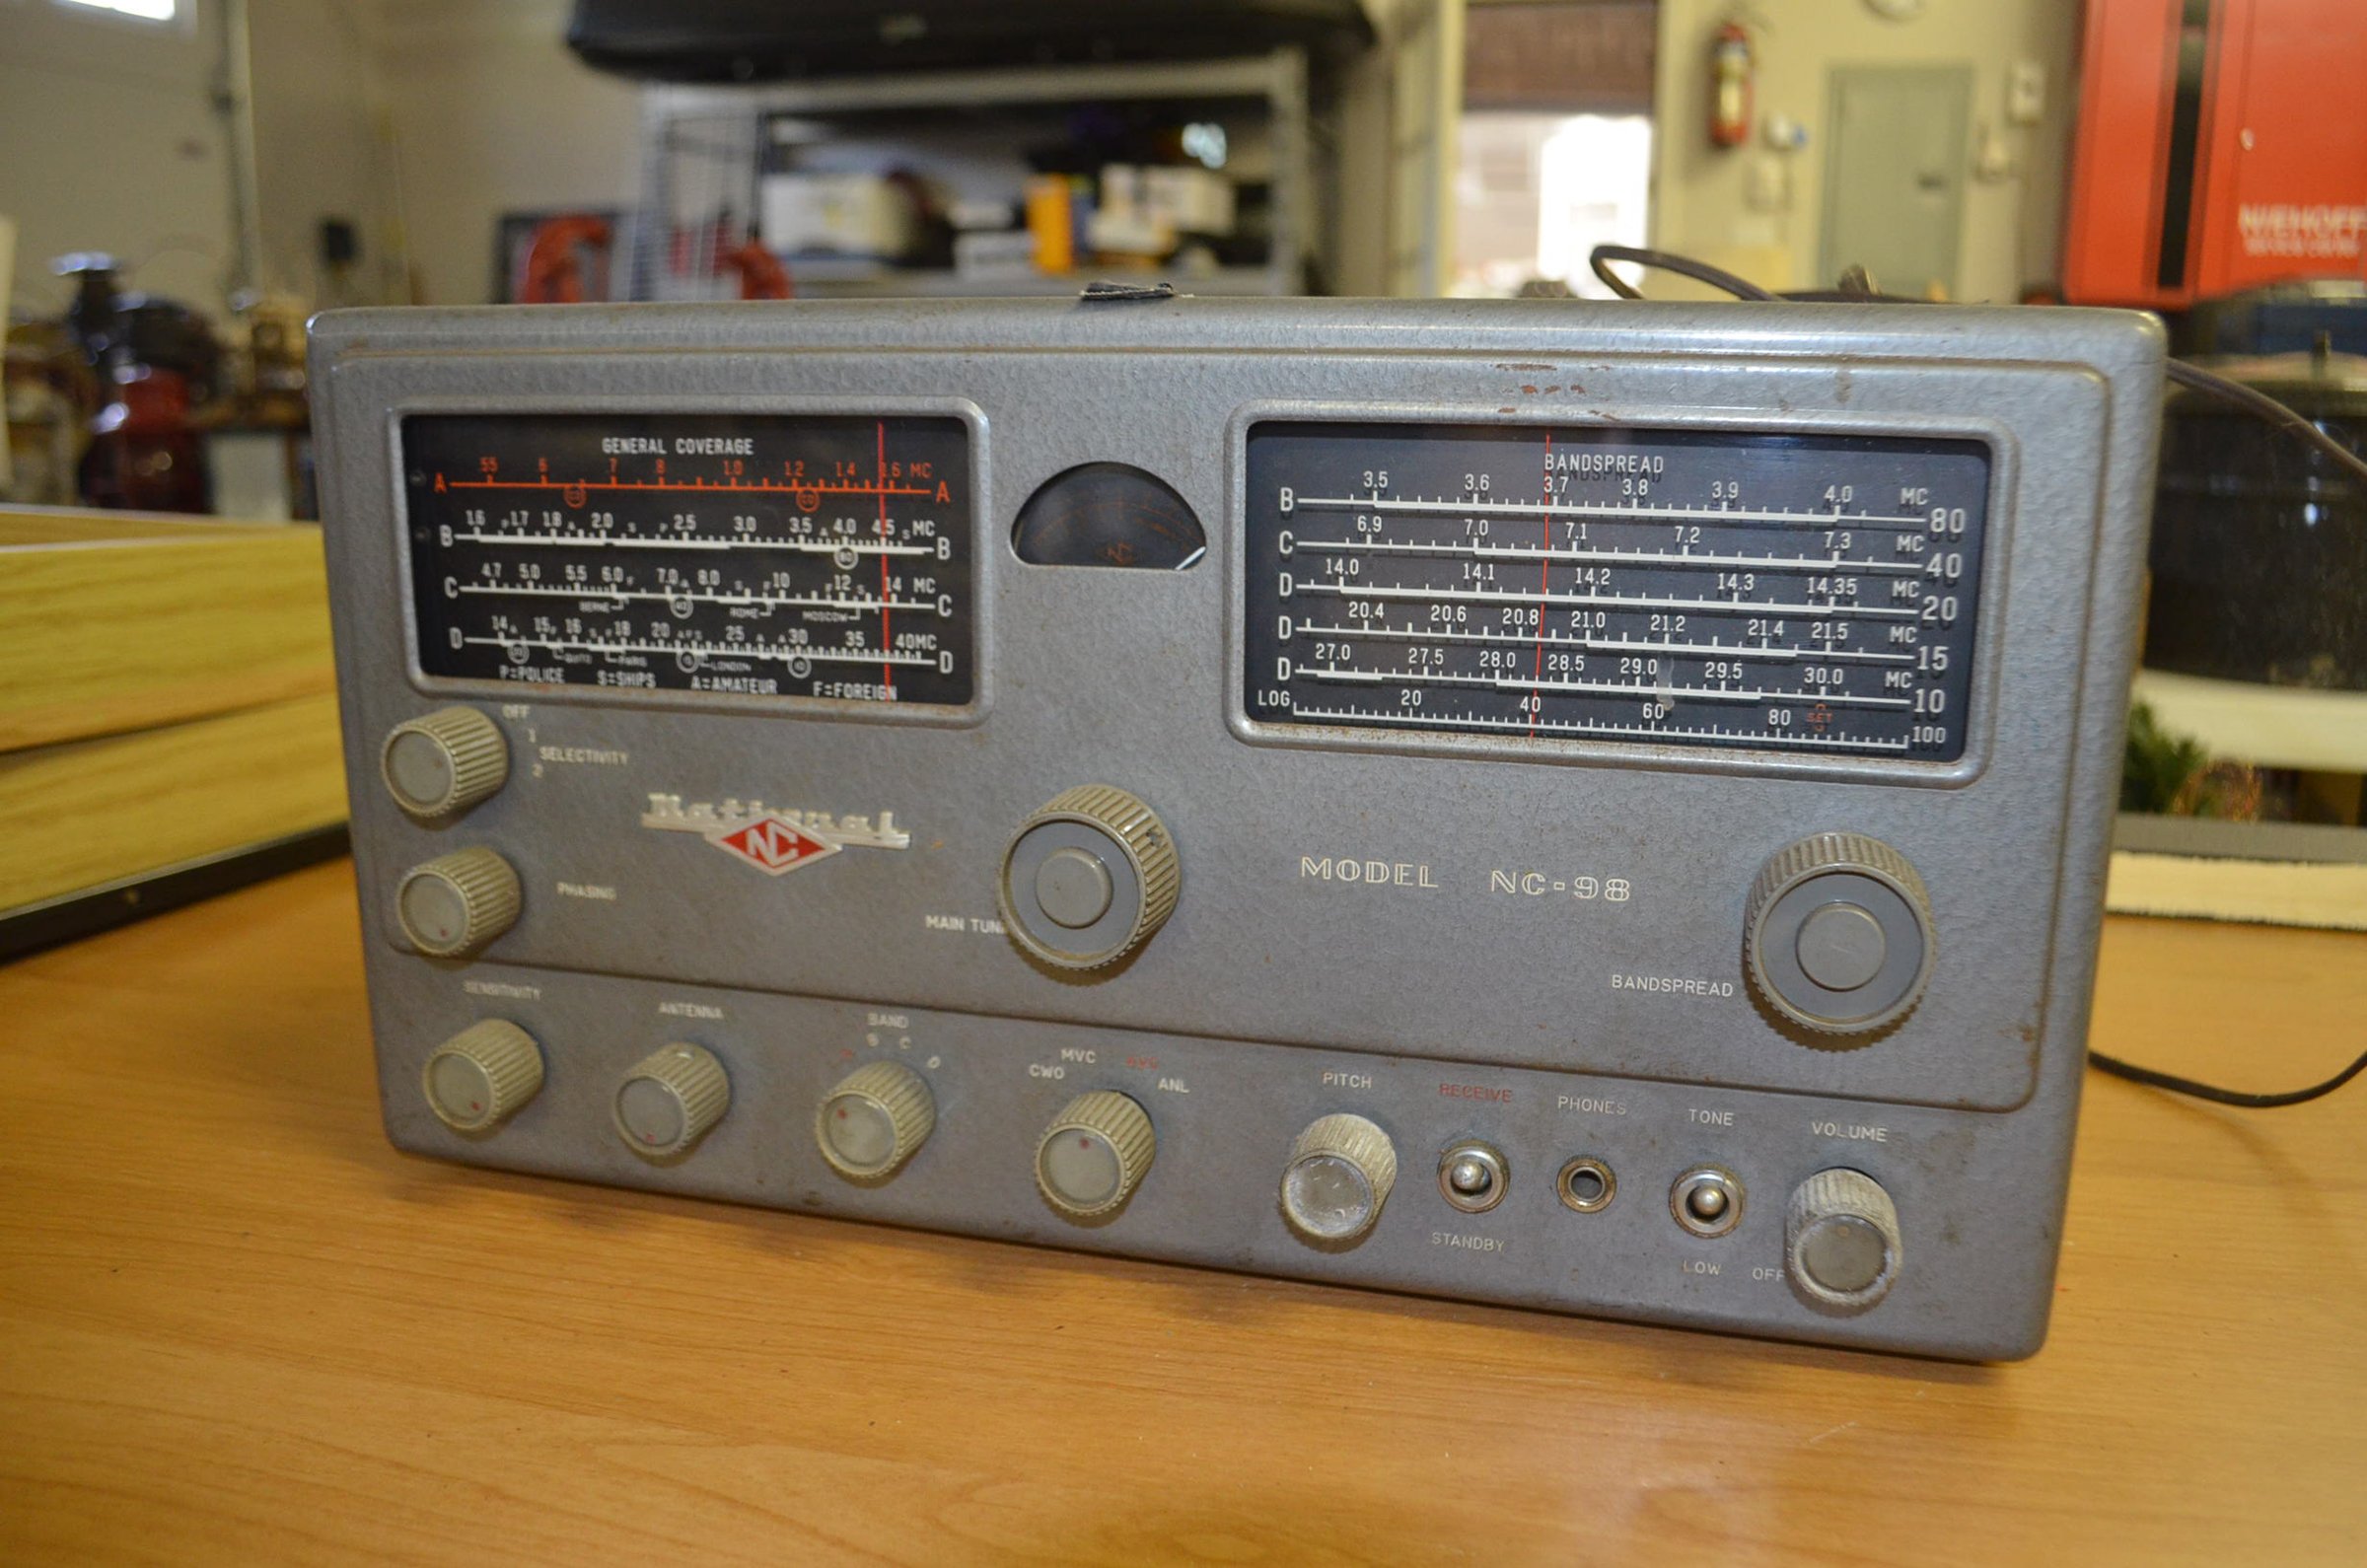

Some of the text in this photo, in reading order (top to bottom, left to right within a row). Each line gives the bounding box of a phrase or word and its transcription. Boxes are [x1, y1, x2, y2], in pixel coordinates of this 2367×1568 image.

[602, 438, 753, 456] GENERAL COVERAGE
[909, 462, 932, 478] MC
[1544, 454, 1664, 473] BANDSPREAD
[434, 472, 448, 493] A
[936, 480, 951, 504] A
[1280, 470, 1967, 534] B 3.5 3.6 3.7 3.8 3.9 4.0 MC 80
[439, 525, 454, 547] B
[912, 520, 935, 537] MC
[938, 536, 951, 560] B
[1279, 515, 1963, 579] C 6.9 7.0 7.1 7.2 7.3 MC 40
[444, 576, 459, 600] C
[833, 574, 852, 591] 12
[886, 576, 902, 593] 14
[913, 577, 936, 594] MC
[938, 594, 953, 617] C
[1279, 558, 1958, 621] D 14.0 14.1 14.2 14.3 14.35 MC 20
[1278, 602, 1949, 671] D 20.4 20.6 20.8 21.0 21.2 21.4 21.5 MC 15
[449, 626, 464, 650] D
[725, 625, 745, 641] 25
[788, 628, 809, 645] 30
[845, 630, 865, 648] 35
[939, 651, 954, 675] D
[1277, 643, 1945, 714] D 27.0 27.5 28.0 28.5 29.0 29.5 30.0 MC 10
[813, 681, 897, 701] F=FOREIGN
[502, 704, 530, 719] OFF
[1257, 689, 1947, 744] LOG 20 40 60 80 100
[539, 746, 630, 765] SELECTIVITY
[1301, 856, 1630, 901] MODEL NC-98
[556, 882, 617, 900] PHASING
[925, 914, 965, 932] MAIN
[1612, 974, 1734, 997] BANDSPREAD
[659, 1002, 724, 1020] ANTENNA
[868, 1013, 909, 1030] BAND
[1061, 1047, 1097, 1064] MVC
[1029, 1064, 1065, 1080] CWO
[1324, 1072, 1372, 1090] PITCH
[1157, 1077, 1190, 1094] ANL
[1439, 1083, 1514, 1104] RECEIVE
[1557, 1096, 1627, 1116] PHONES
[1688, 1108, 1734, 1127] TONE
[1812, 1121, 1889, 1143] VOLUME
[1432, 1232, 1505, 1252] STANDBY
[1683, 1259, 1721, 1276] LOW
